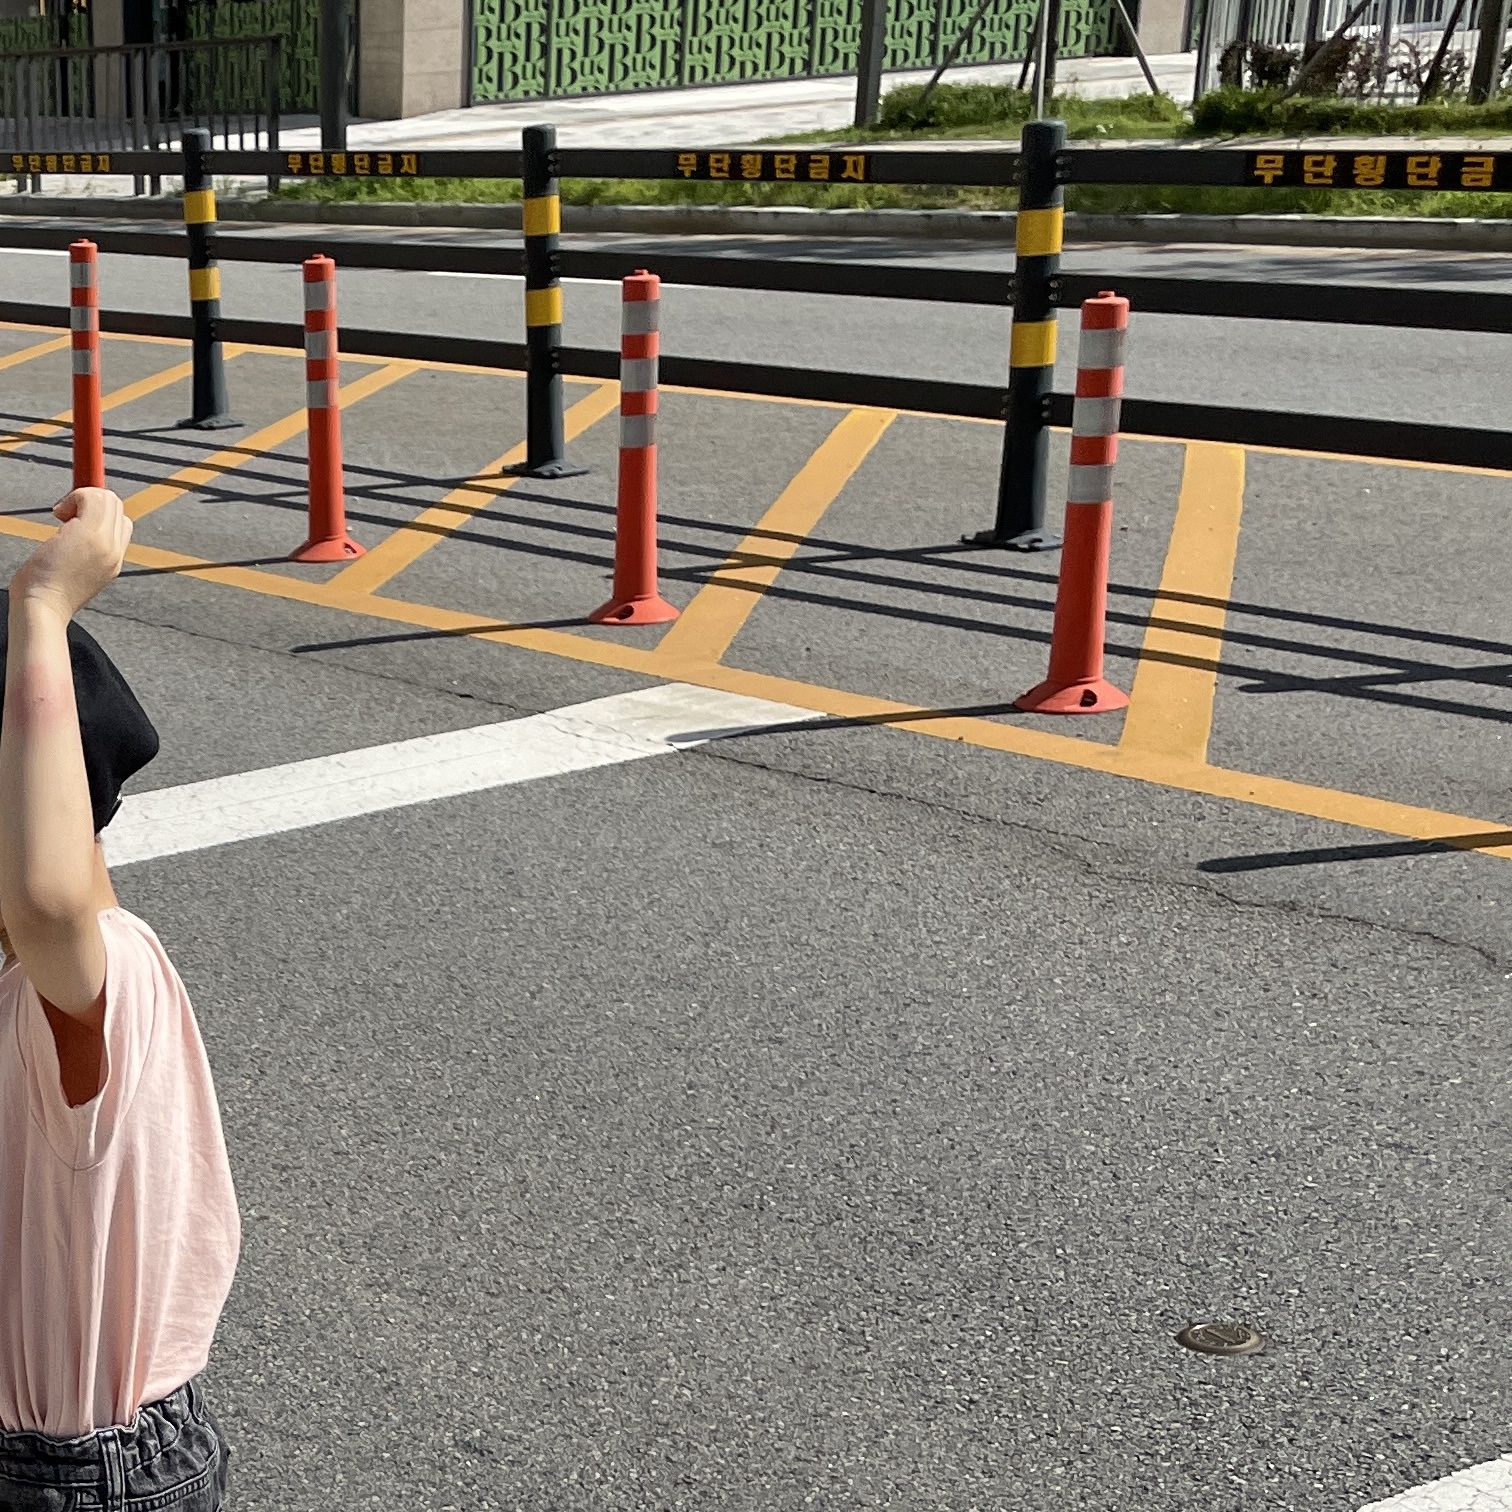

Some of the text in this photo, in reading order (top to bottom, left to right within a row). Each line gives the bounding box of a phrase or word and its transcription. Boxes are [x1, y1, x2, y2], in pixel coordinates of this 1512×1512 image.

[287, 153, 418, 175] 무단횡단금지
[677, 153, 865, 181] 무단횡단금지
[1254, 154, 1495, 187] 무단횡단금
